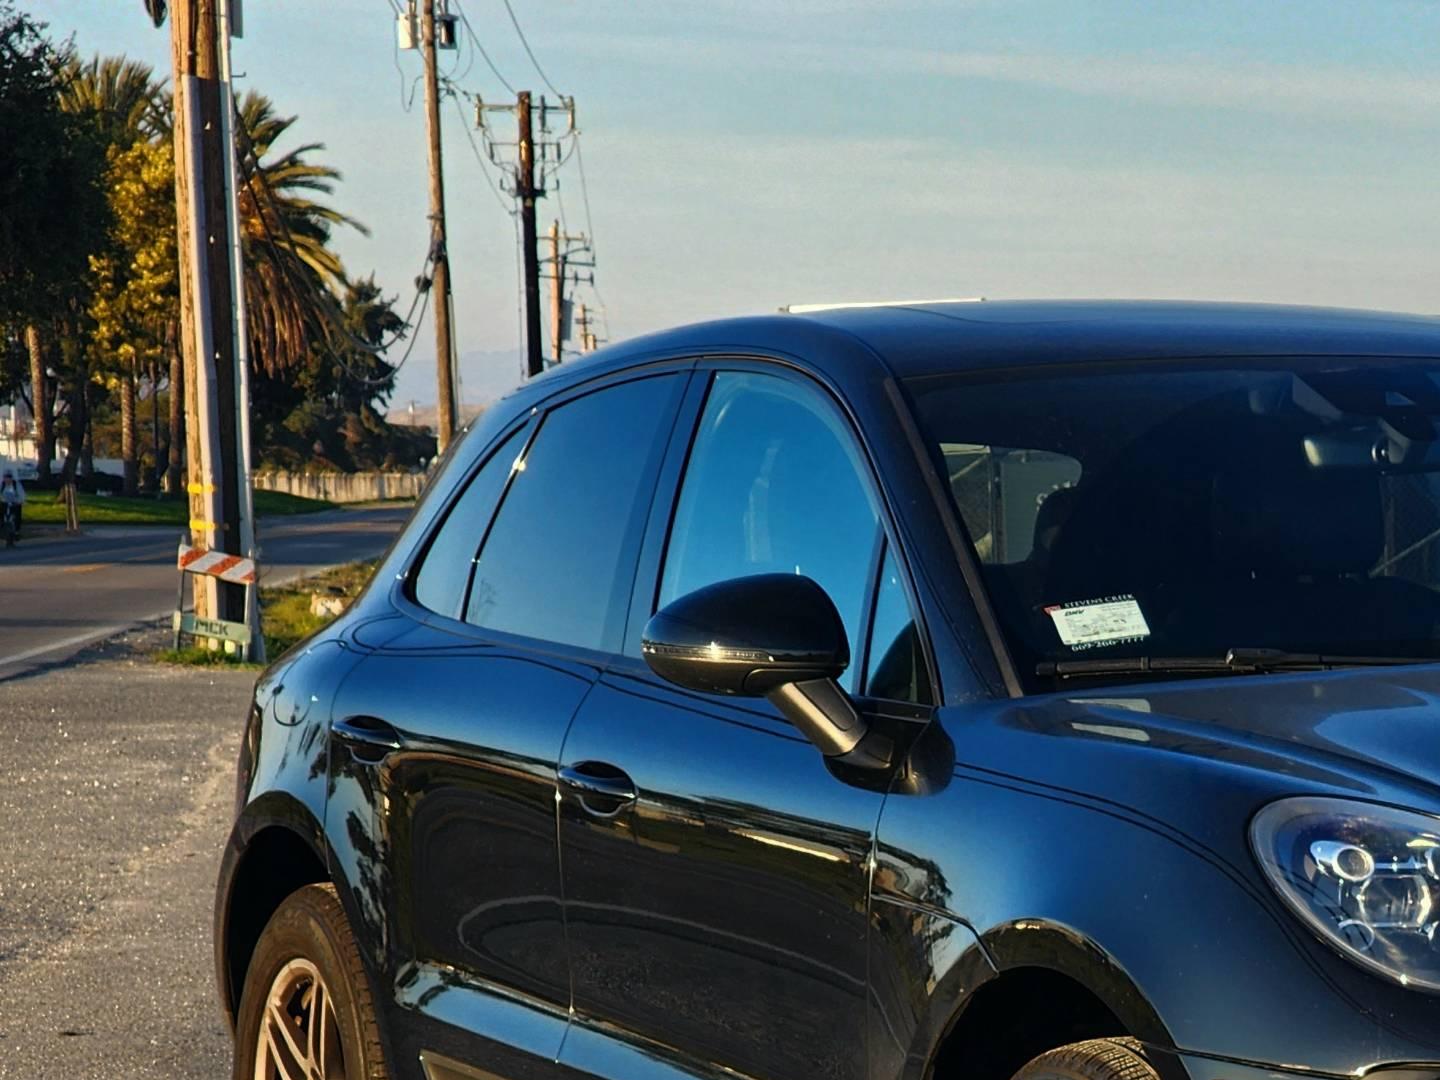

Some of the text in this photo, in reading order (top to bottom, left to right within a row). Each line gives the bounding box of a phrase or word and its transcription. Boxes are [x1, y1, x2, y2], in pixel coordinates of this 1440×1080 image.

[1064, 598, 1103, 608] STEVENS
[1104, 593, 1134, 602] CREEK
[195, 620, 229, 635] MCK
